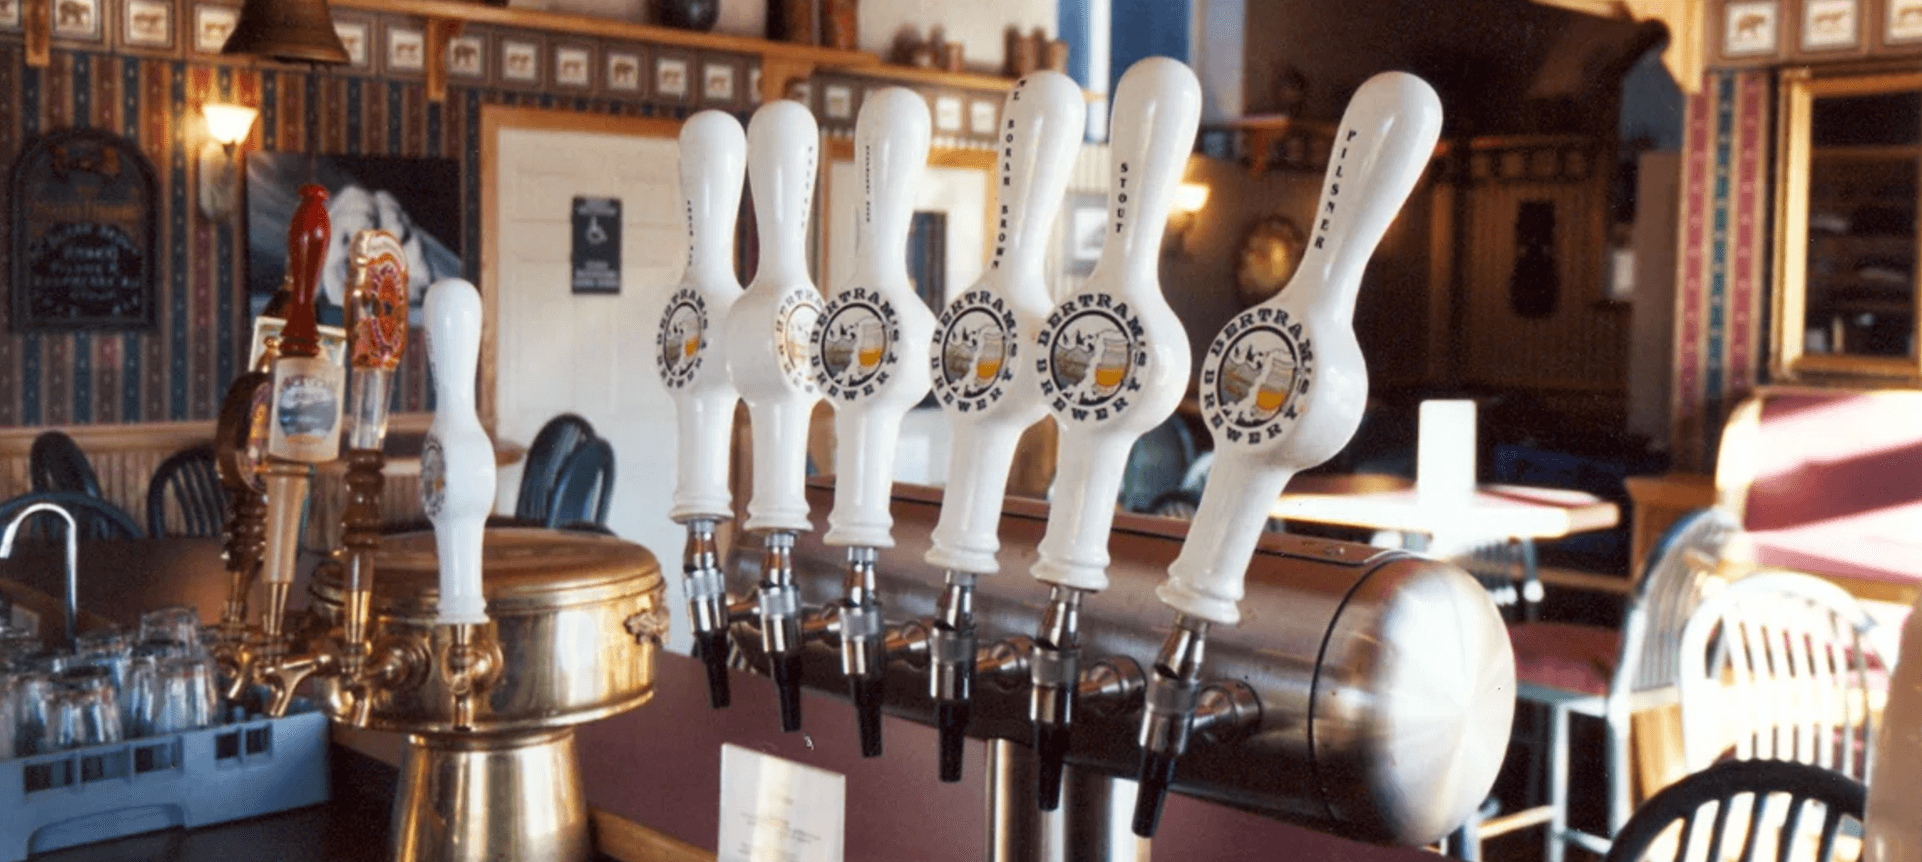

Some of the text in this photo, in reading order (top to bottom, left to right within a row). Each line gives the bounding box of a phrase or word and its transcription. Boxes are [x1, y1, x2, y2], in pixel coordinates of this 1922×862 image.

[1003, 119, 1014, 186] BORAH
[1116, 162, 1128, 233] STOUT
[1314, 129, 1357, 249] PILSNER
[991, 205, 1009, 269] BROWN
[656, 288, 708, 345] BERTRAM'S
[810, 287, 899, 344] BERTRAM'S
[931, 290, 1018, 358] BERTRAM'S
[1037, 293, 1148, 367] BERTRAM'S
[810, 351, 898, 400] BREWERY
[931, 356, 1014, 413] BREWERY
[1210, 308, 1313, 394] BERTRAM'S
[1036, 358, 1141, 421] BREWERY
[1204, 370, 1298, 445] BREWERY
